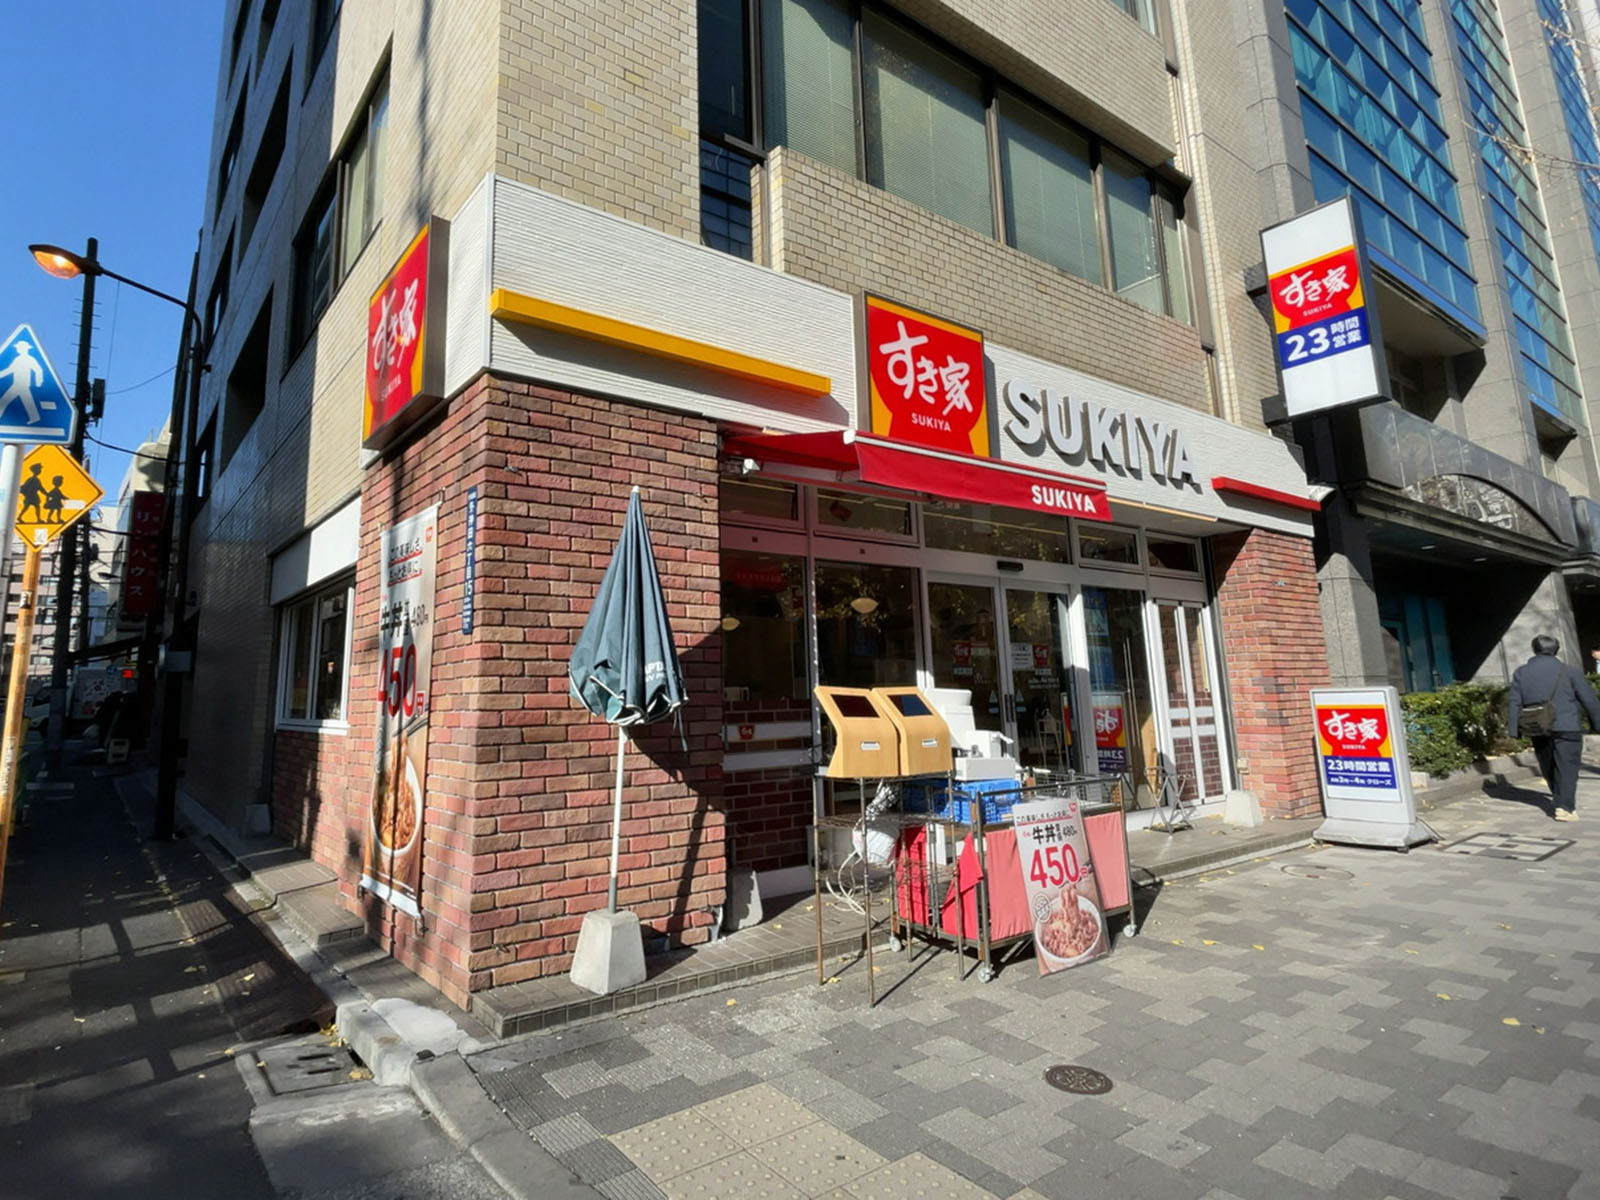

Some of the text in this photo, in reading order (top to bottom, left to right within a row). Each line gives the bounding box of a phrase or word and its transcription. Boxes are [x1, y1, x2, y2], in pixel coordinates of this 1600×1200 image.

[1279, 265, 1350, 308] すき家
[1303, 303, 1333, 317] SUKIYA
[372, 278, 419, 379] すき家
[1285, 327, 1330, 362] 23
[879, 320, 974, 416] すき家
[911, 412, 952, 433] SUKIYA
[1004, 379, 1202, 494] SUKIYA
[1031, 484, 1097, 514] SUKIYA
[1324, 710, 1381, 743] すき家
[1327, 759, 1391, 772] 23時間営業
[1032, 824, 1056, 845] 牛丼
